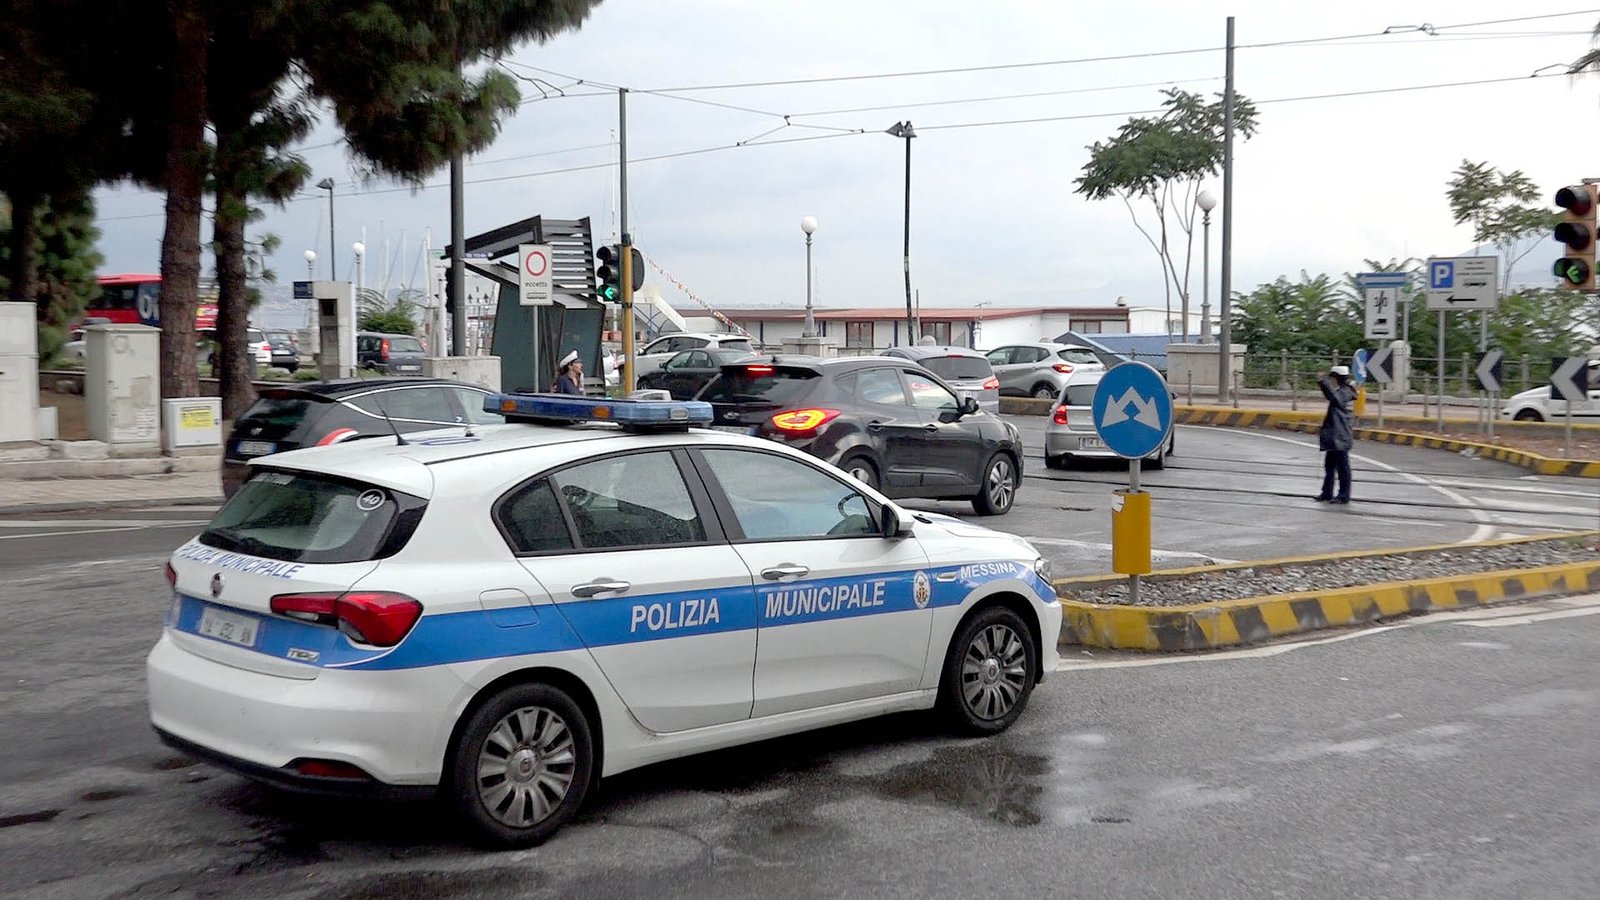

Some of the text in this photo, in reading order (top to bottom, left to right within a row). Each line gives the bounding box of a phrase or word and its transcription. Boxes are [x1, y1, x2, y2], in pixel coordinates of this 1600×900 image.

[1434, 265, 1451, 286] P
[362, 494, 380, 505] 40
[217, 553, 304, 579] MUNICIPALE
[630, 562, 1017, 633] POLIZIA MUNICIPALE MESSINA
